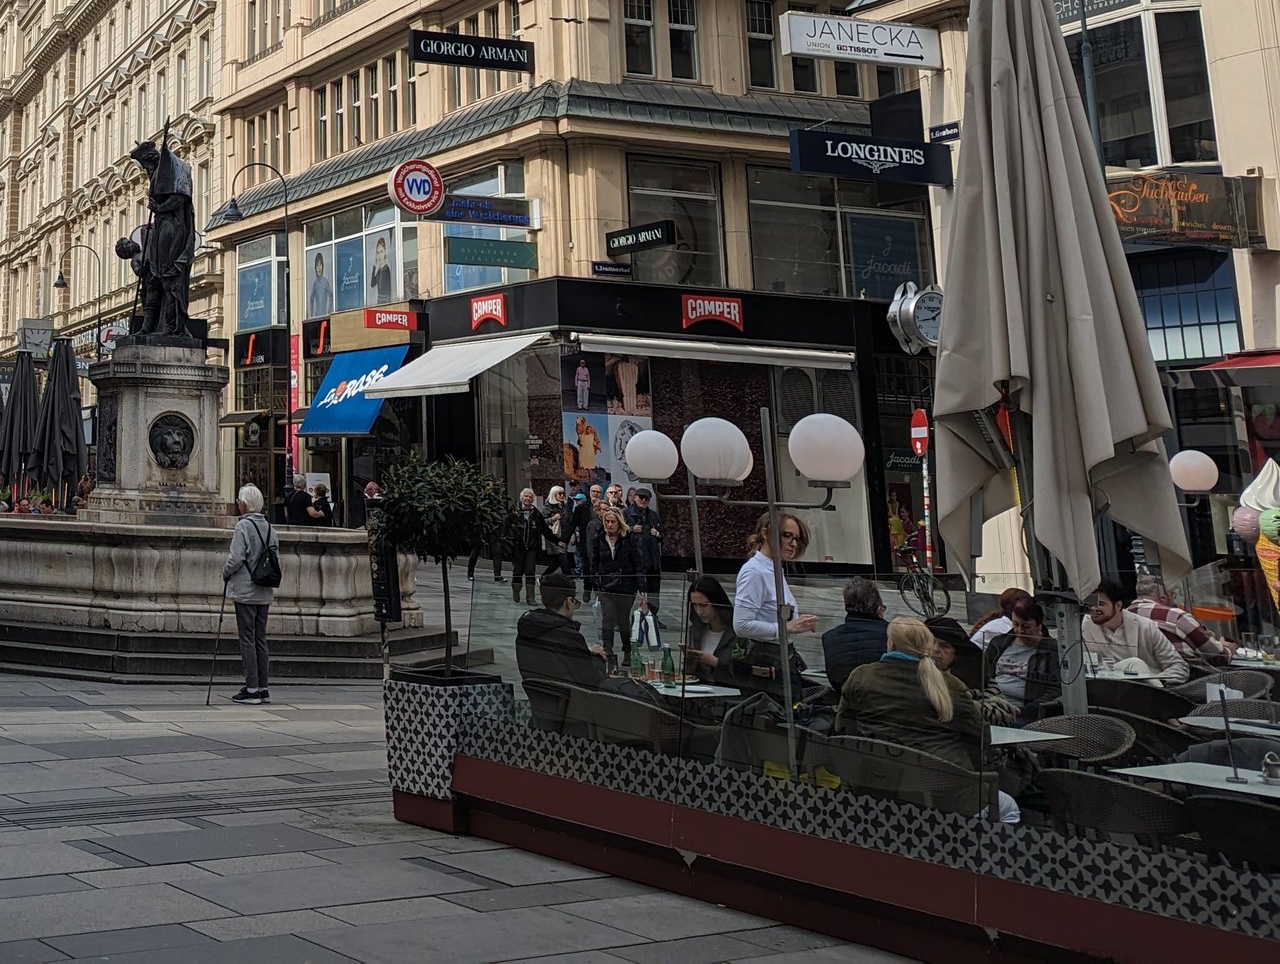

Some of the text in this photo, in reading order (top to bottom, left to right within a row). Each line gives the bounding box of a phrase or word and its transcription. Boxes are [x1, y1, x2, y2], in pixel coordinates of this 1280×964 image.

[806, 19, 923, 49] JANECKA
[806, 41, 831, 49] UNION
[420, 39, 528, 63] GIORGIO ARMANI
[848, 45, 878, 54] TISSOT
[825, 140, 925, 165] LONGINES
[397, 162, 441, 187] Versicherungsdienst
[407, 178, 431, 196] VVD
[610, 228, 662, 248] GIORGIO ARMANI
[376, 312, 408, 327] CAMPER
[473, 299, 502, 321] CAMPER
[688, 299, 740, 323] CAMPER
